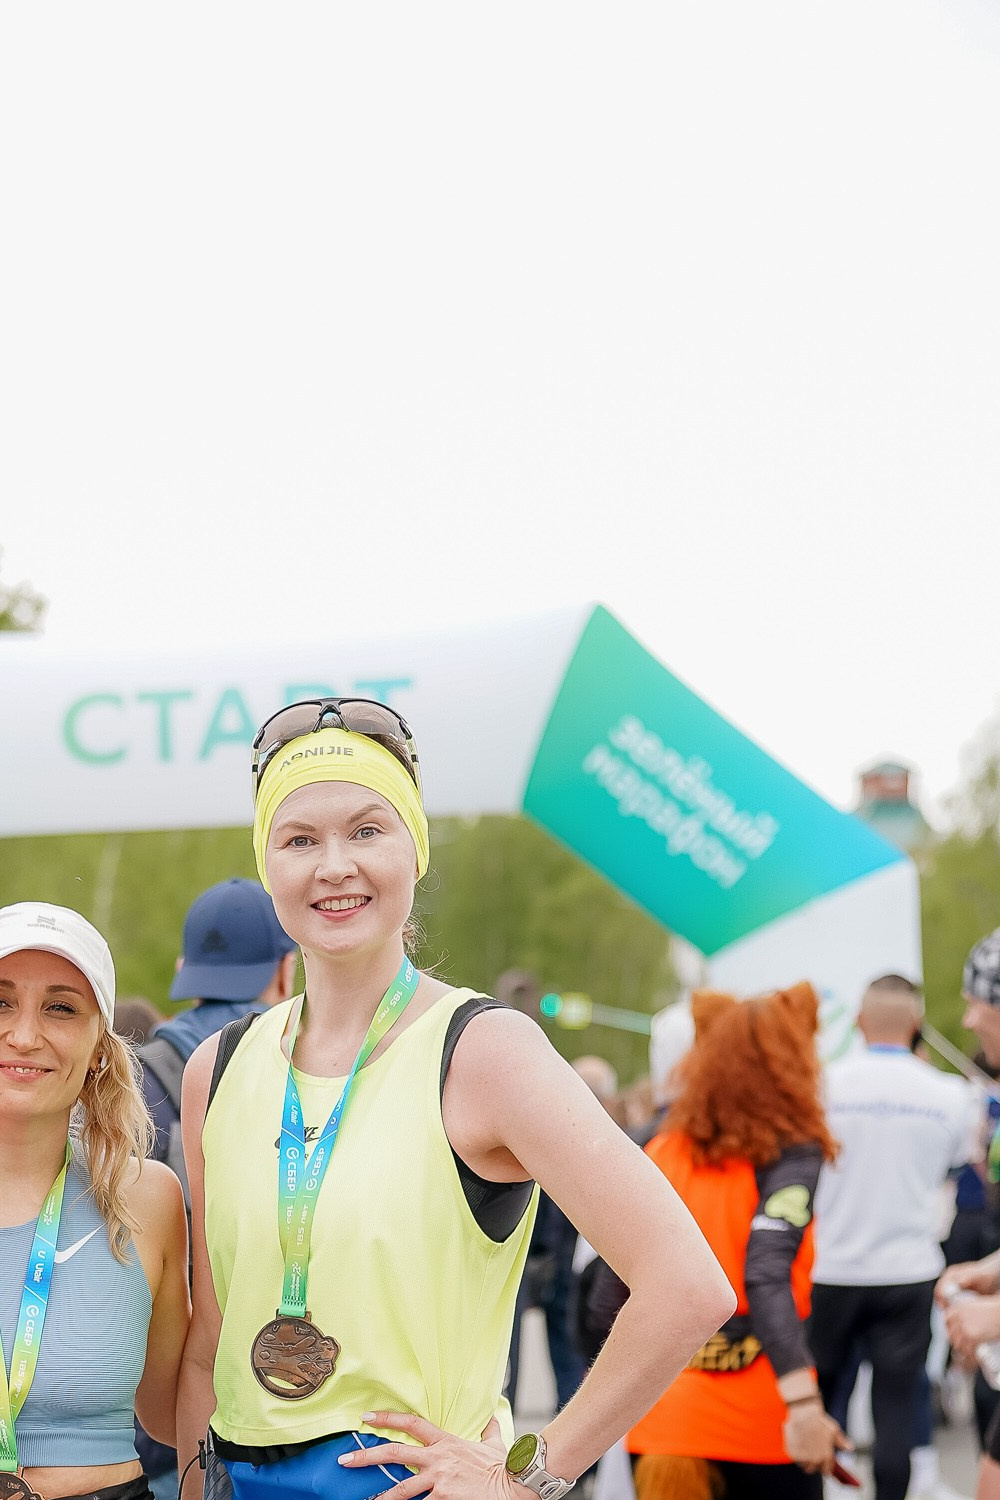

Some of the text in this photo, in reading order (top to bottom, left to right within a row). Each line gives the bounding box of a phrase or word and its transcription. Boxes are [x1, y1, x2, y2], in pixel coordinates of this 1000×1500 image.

[62, 677, 412, 766] СТА
[390, 990, 403, 1007] 185
[312, 1147, 325, 1176] СБЕР
[287, 1161, 297, 1192] СБЕР
[23, 1319, 36, 1347] СБЕР
[18, 1359, 27, 1378] 185
